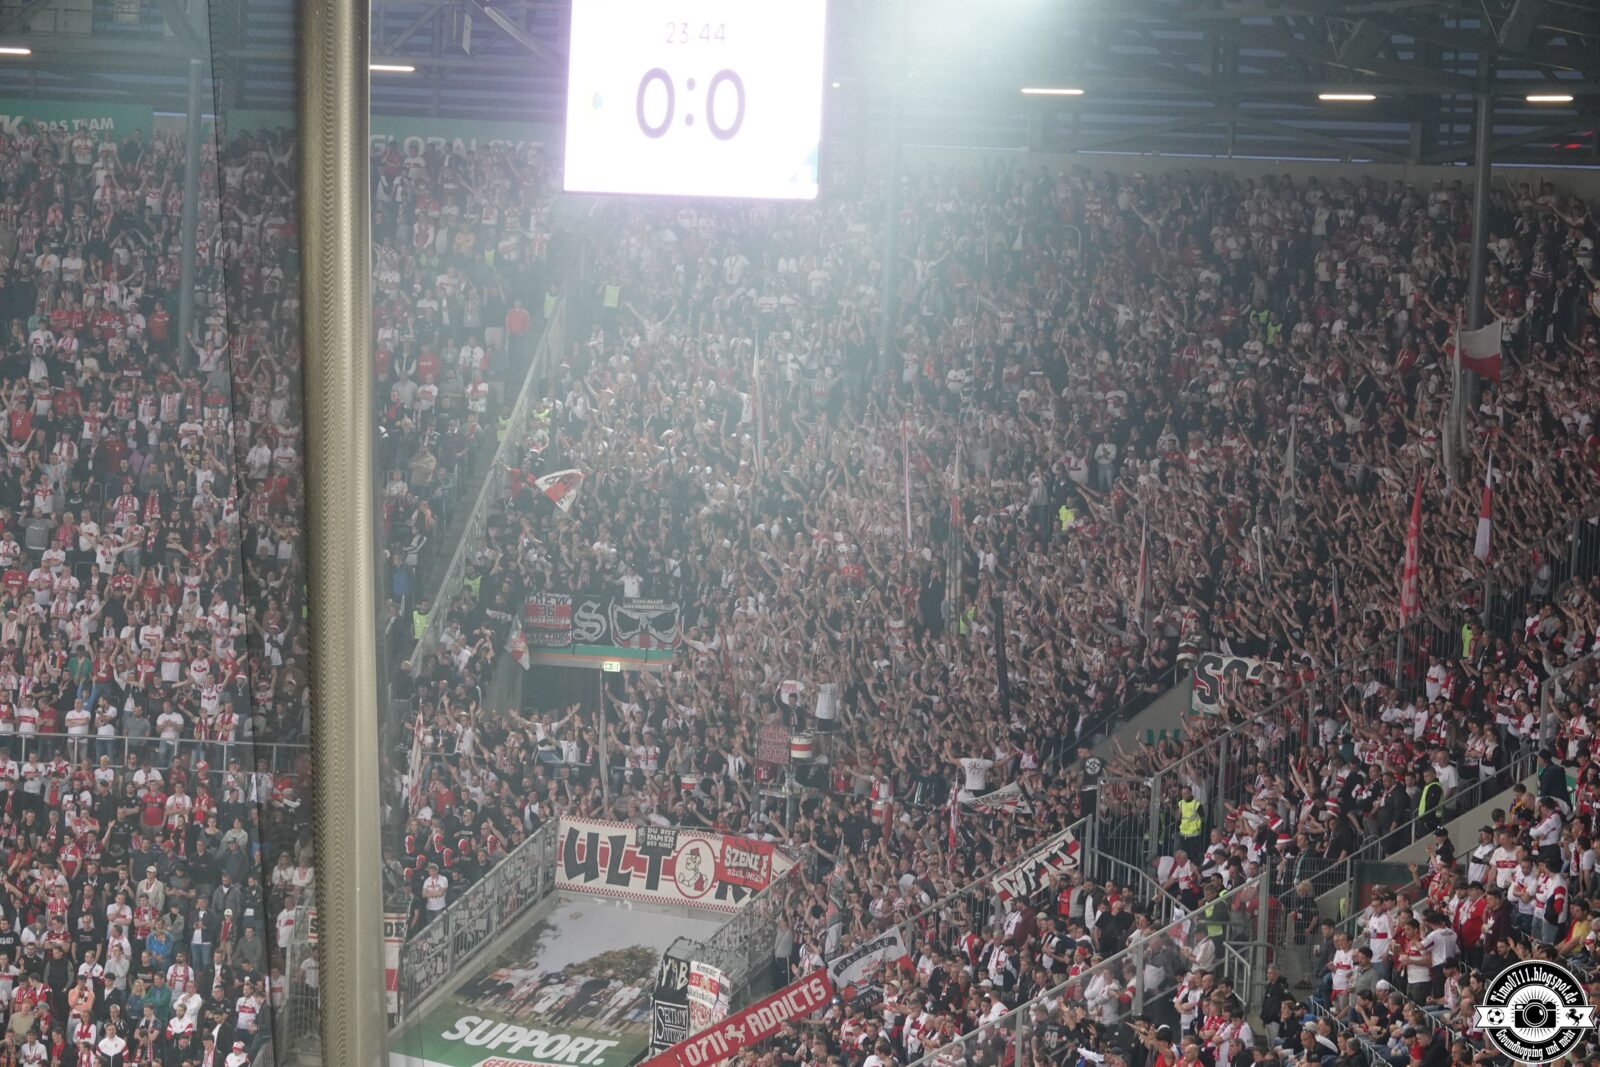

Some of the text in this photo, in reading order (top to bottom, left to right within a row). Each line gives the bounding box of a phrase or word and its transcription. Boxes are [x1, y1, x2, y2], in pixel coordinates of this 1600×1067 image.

[665, 21, 727, 45] 23:44
[0, 114, 24, 137] K
[646, 834, 675, 843] IMMER
[724, 843, 761, 872] SZENE
[684, 977, 827, 1067] 0711 ADDICTS
[441, 1015, 620, 1066] SUPPORT.
